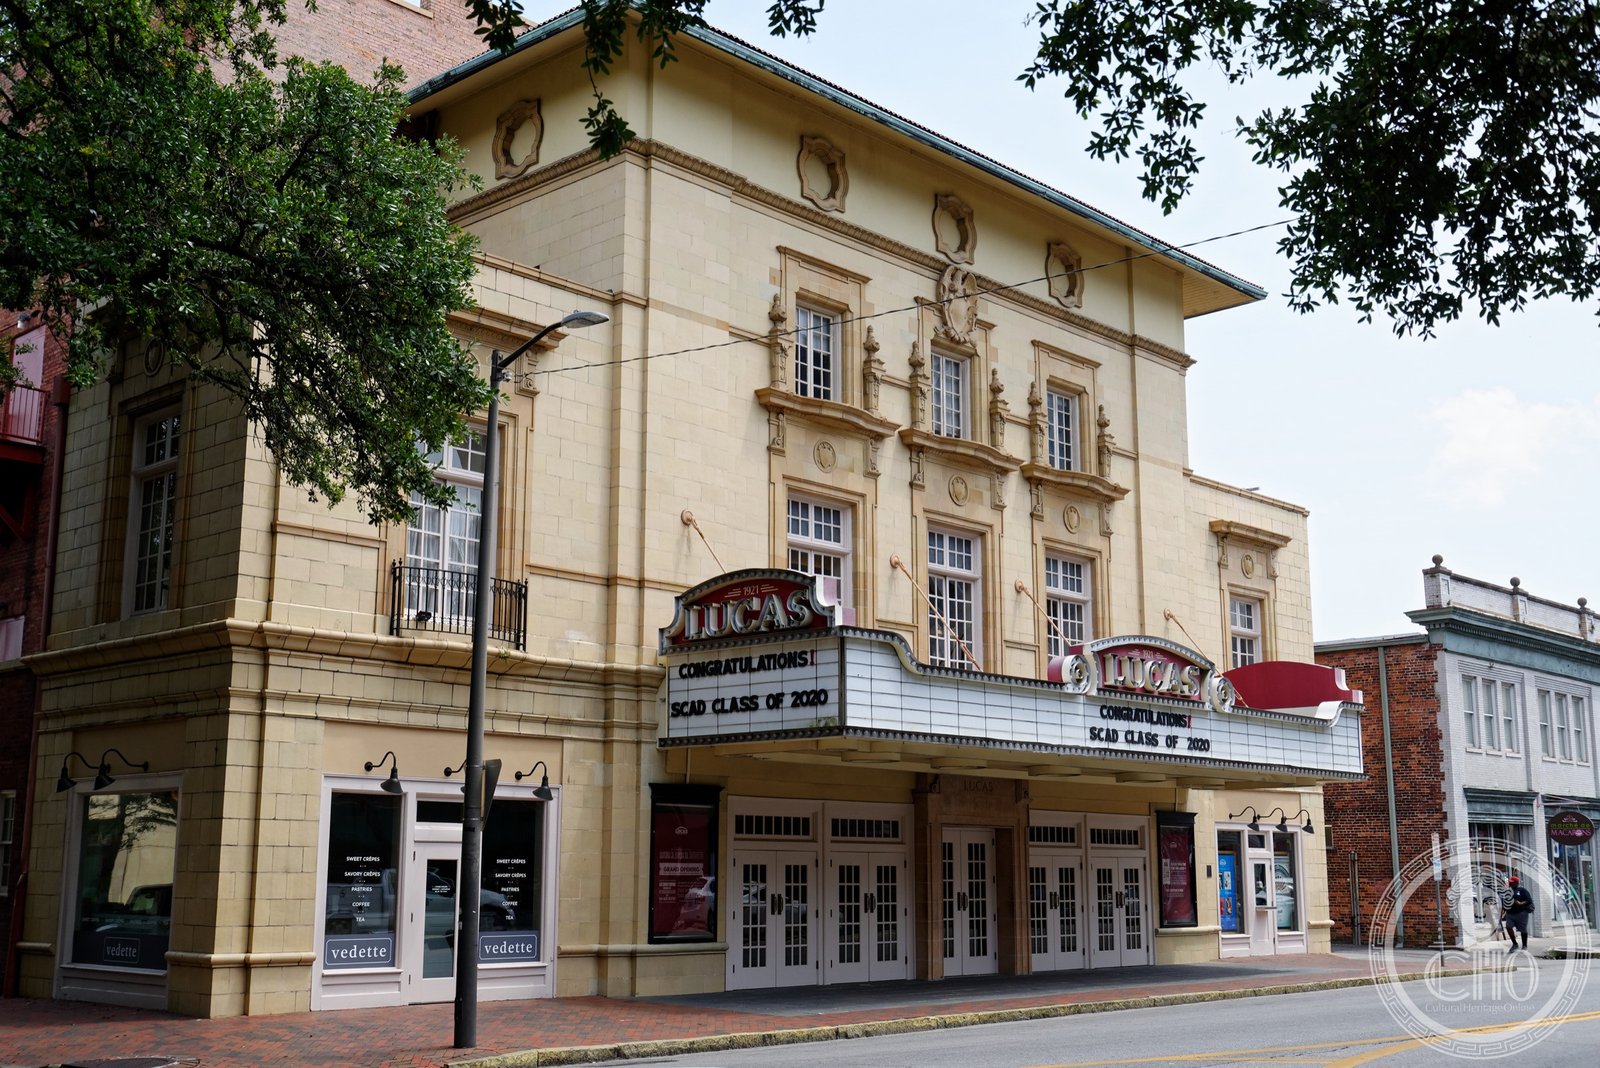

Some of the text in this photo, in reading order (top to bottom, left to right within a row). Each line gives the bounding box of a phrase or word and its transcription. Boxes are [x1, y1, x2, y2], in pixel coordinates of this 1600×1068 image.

[743, 585, 759, 595] 1921
[684, 590, 814, 640] LUCAS
[679, 649, 815, 679] CONGRATULATIONS!
[1103, 653, 1200, 696] LUCAS
[670, 689, 829, 718] SCAD CLASS OF 2020
[1100, 704, 1192, 729] CONGRATULATIONS!
[1089, 726, 1211, 752] SCAD CLASS OF 2020
[963, 780, 994, 792] LUCAS
[106, 943, 137, 958] vedette
[331, 944, 387, 959] vedette
[484, 941, 533, 955] vedette
